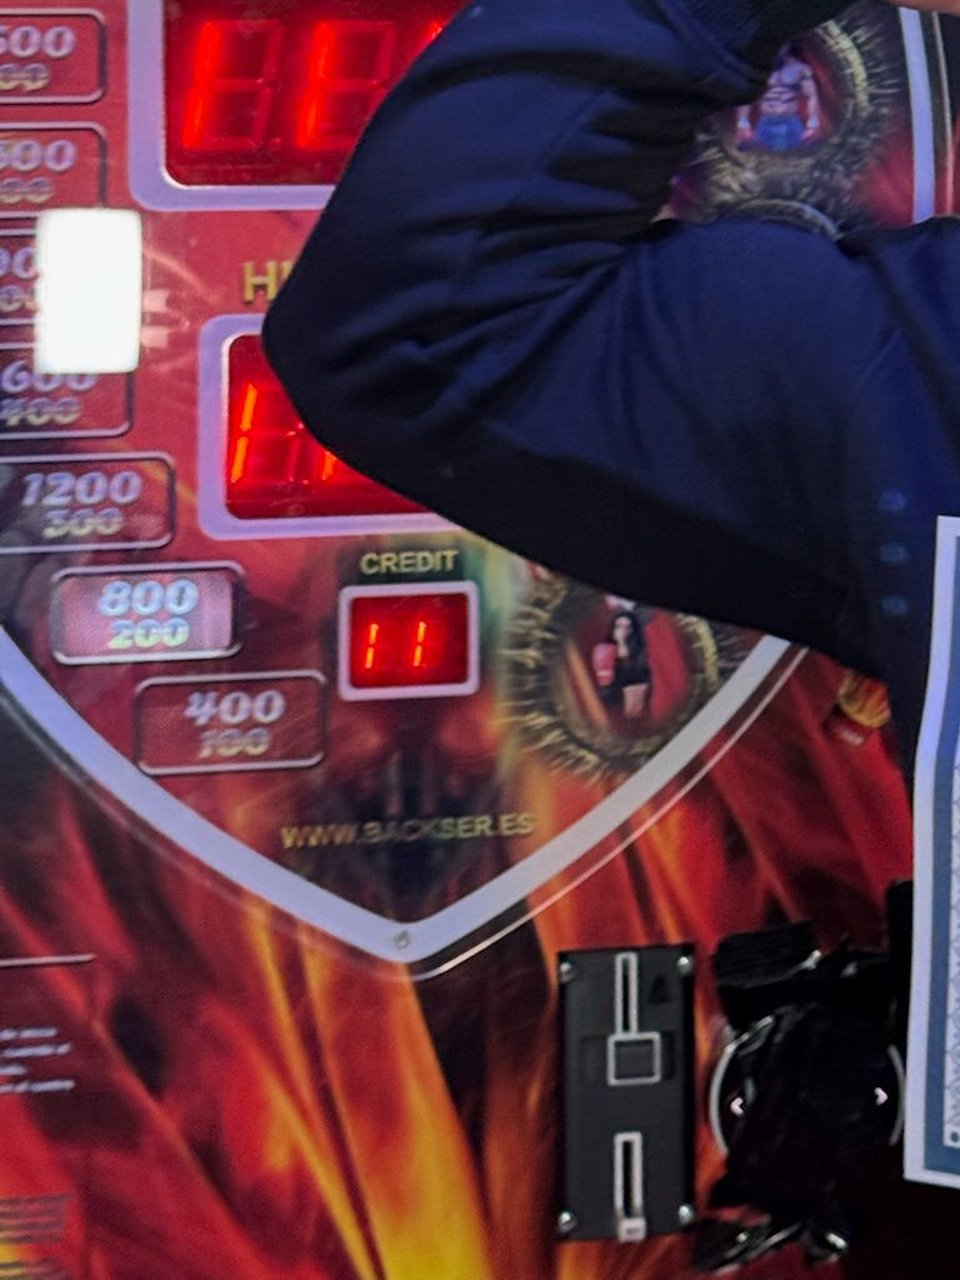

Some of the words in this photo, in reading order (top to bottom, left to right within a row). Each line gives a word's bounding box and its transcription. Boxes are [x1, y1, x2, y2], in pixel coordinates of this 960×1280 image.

[22, 471, 141, 506] 1200
[361, 550, 458, 575] CREDIT
[99, 580, 198, 616] 800
[107, 618, 190, 649] 200
[184, 690, 286, 726] 400
[280, 813, 535, 850] WWW.BACKSER.ES
